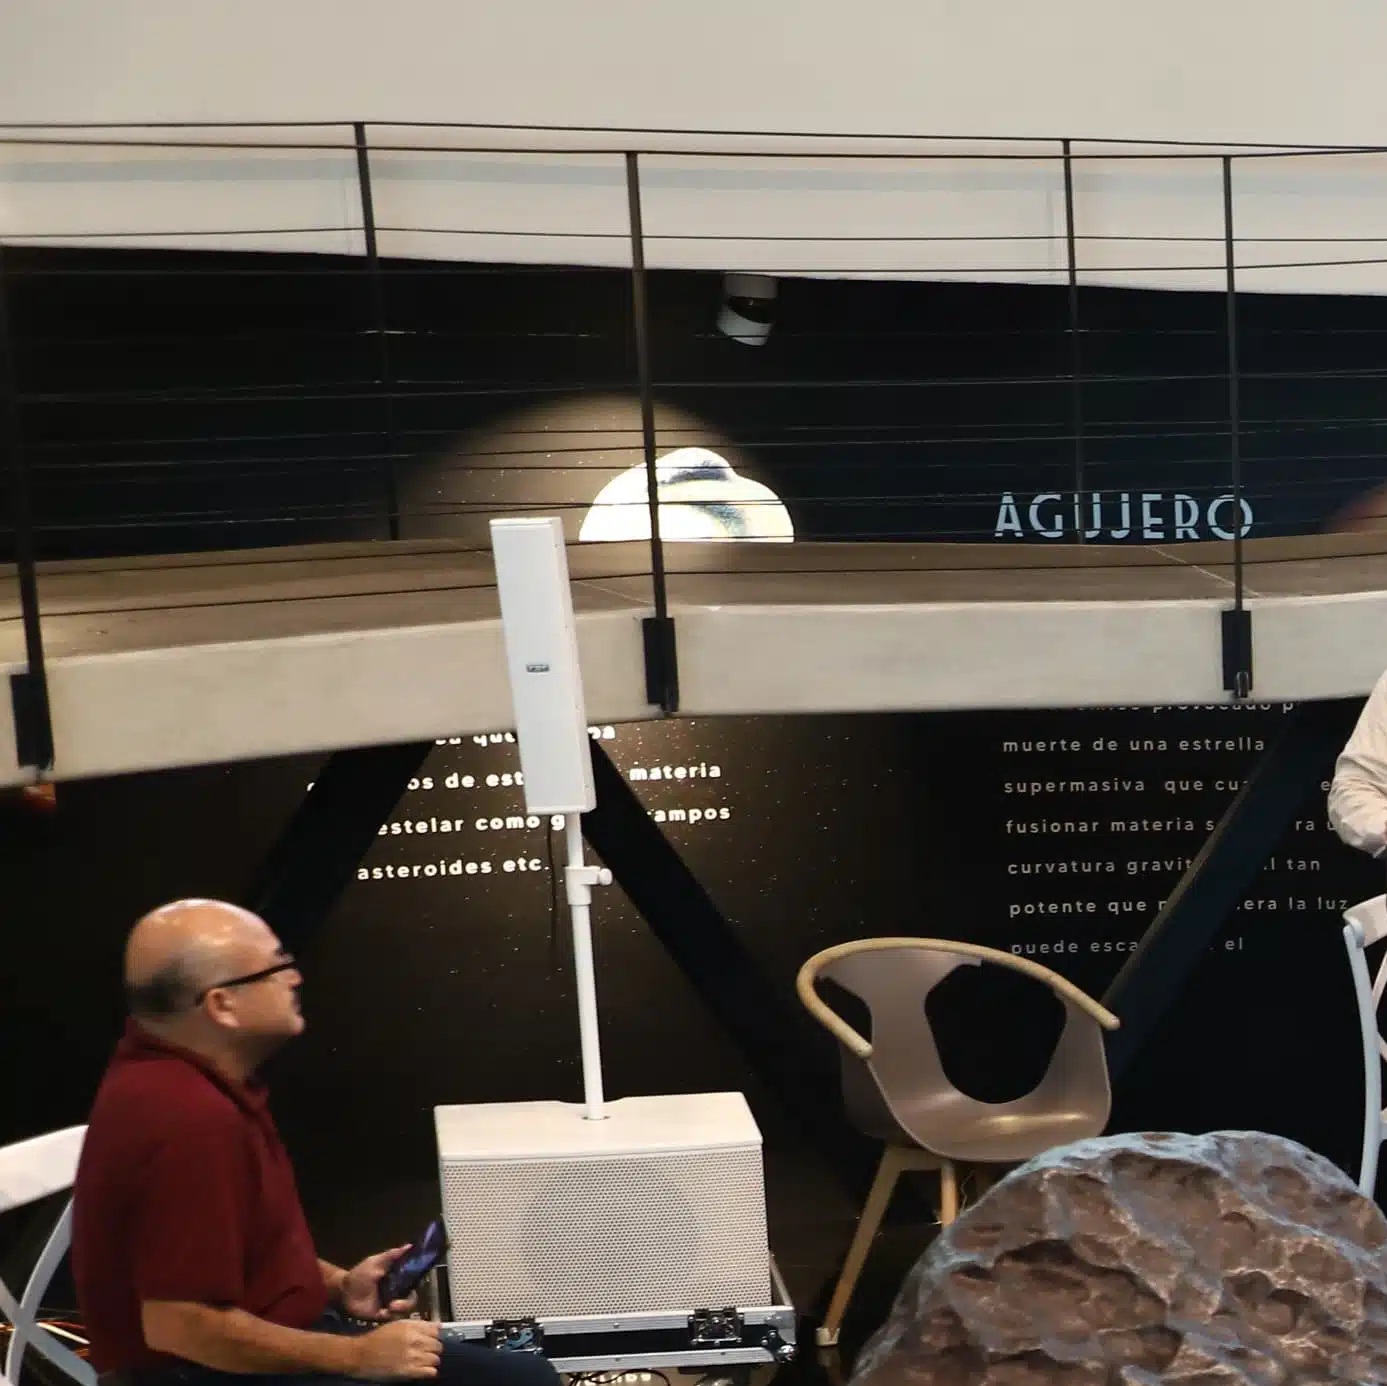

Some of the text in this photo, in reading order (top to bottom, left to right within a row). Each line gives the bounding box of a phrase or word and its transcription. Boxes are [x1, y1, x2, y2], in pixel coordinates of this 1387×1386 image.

[994, 491, 1253, 541] AGUJERO
[1003, 736, 1265, 752] muerte de una estrella
[445, 772, 475, 789] de
[629, 762, 721, 781] materia
[1004, 778, 1145, 796] supermasiva
[1165, 778, 1203, 793] que
[475, 815, 540, 831] como
[647, 807, 731, 824] ampos
[1006, 819, 1099, 834] fusionar
[1111, 818, 1194, 832] materia
[358, 857, 550, 880] asteroides etc.
[1007, 858, 1116, 875] curvatura
[1009, 899, 1097, 917] potente
[1108, 899, 1147, 915] que
[1289, 897, 1307, 911] la
[1318, 896, 1349, 911] luz
